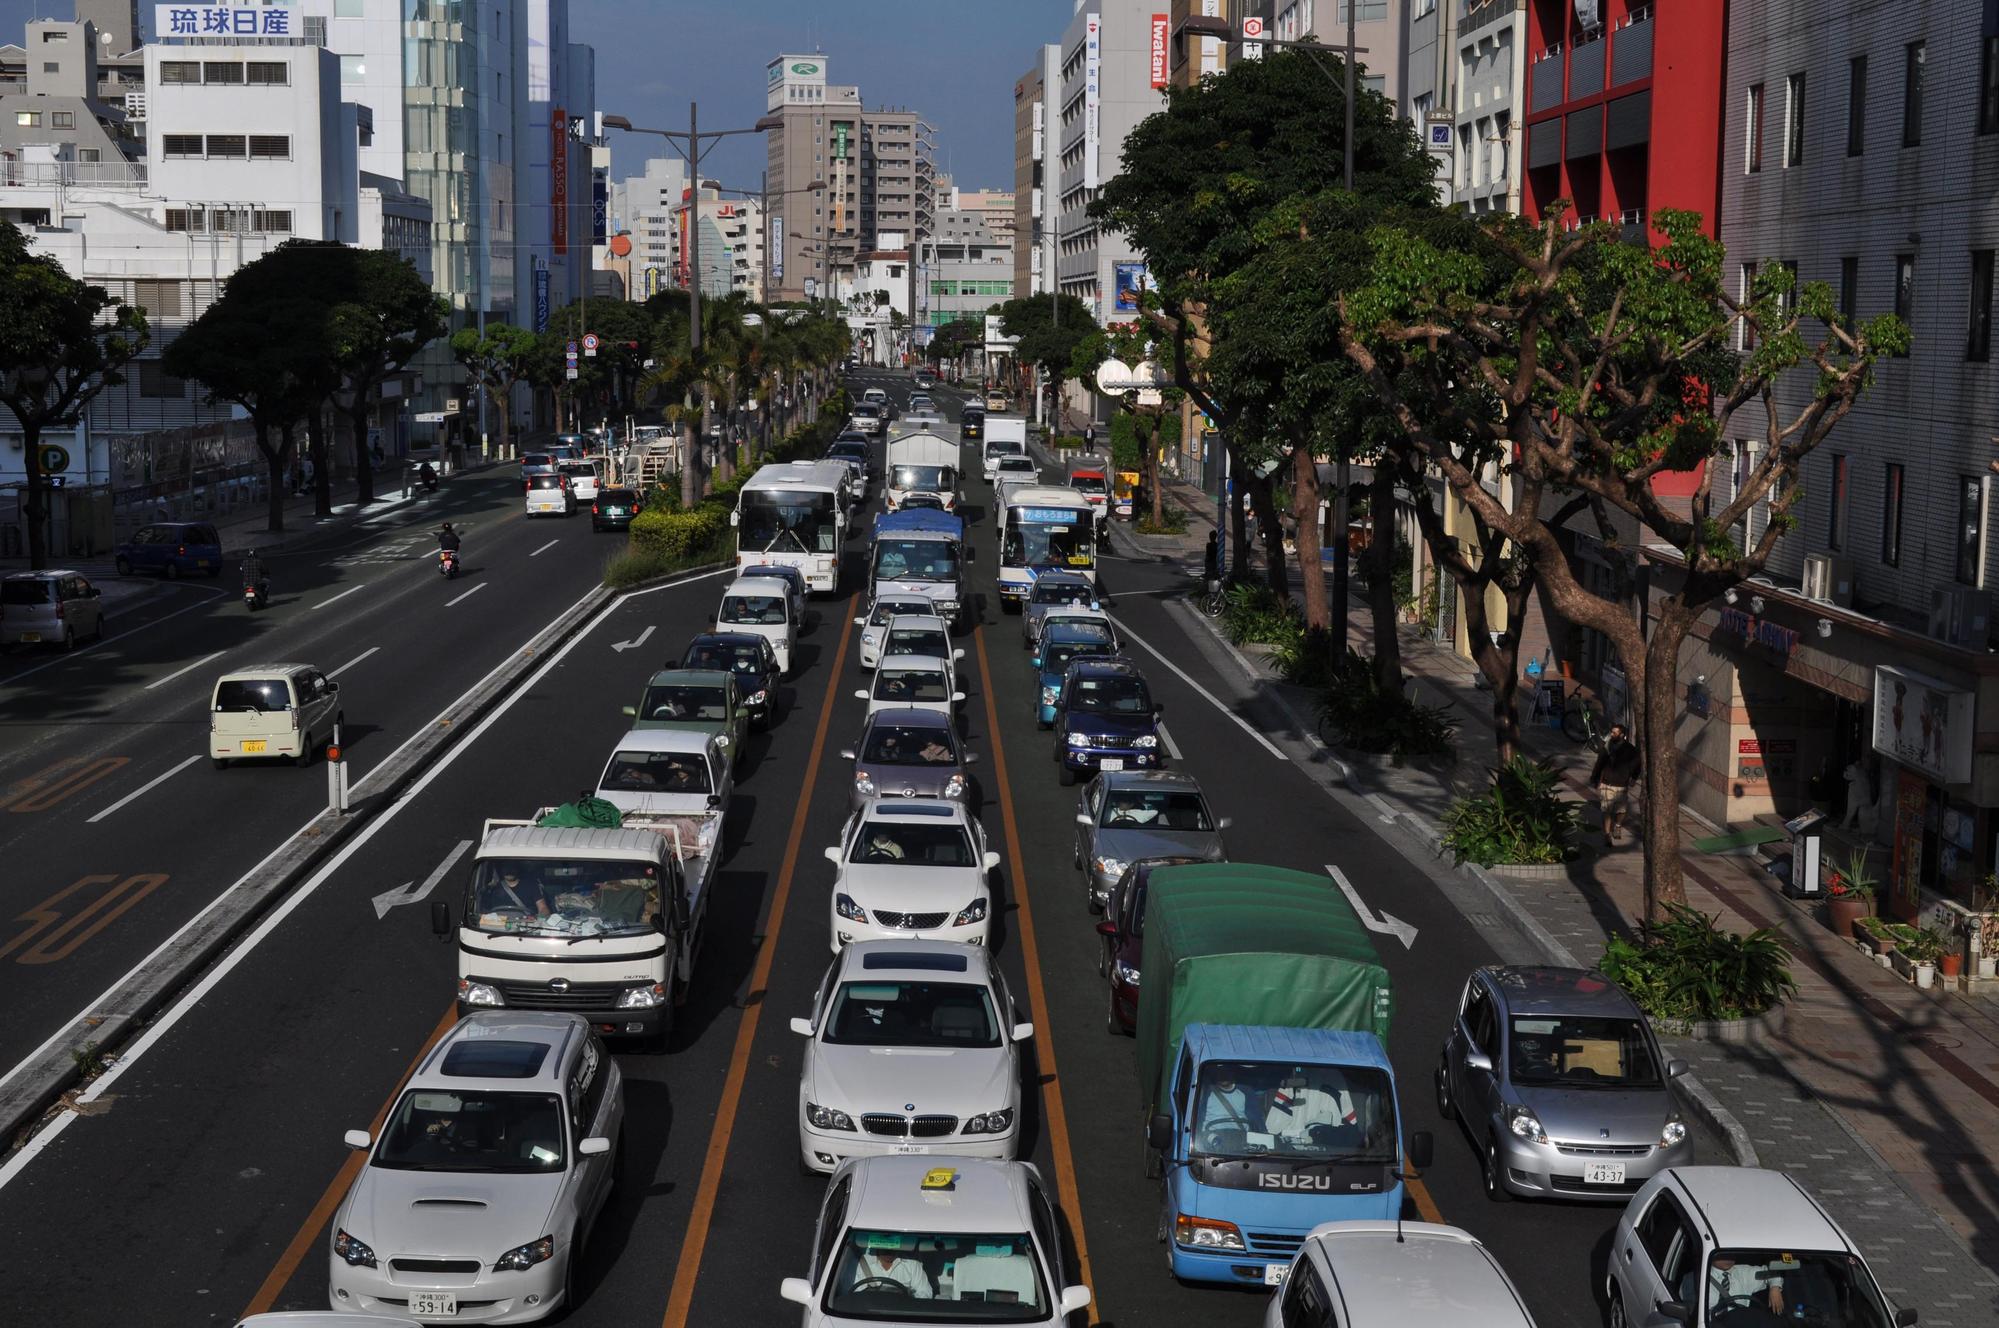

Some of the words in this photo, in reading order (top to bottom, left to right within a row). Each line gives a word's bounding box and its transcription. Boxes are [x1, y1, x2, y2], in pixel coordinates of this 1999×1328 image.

[169, 8, 290, 35] 琉球日産
[1152, 20, 1166, 83] Iwatani
[555, 157, 565, 195] RASSO
[594, 199, 605, 226] OCS
[48, 450, 62, 469] P
[1258, 1172, 1331, 1190] ISUZU
[1593, 1171, 1623, 1182] 43-37
[418, 1301, 454, 1313] 59-14
